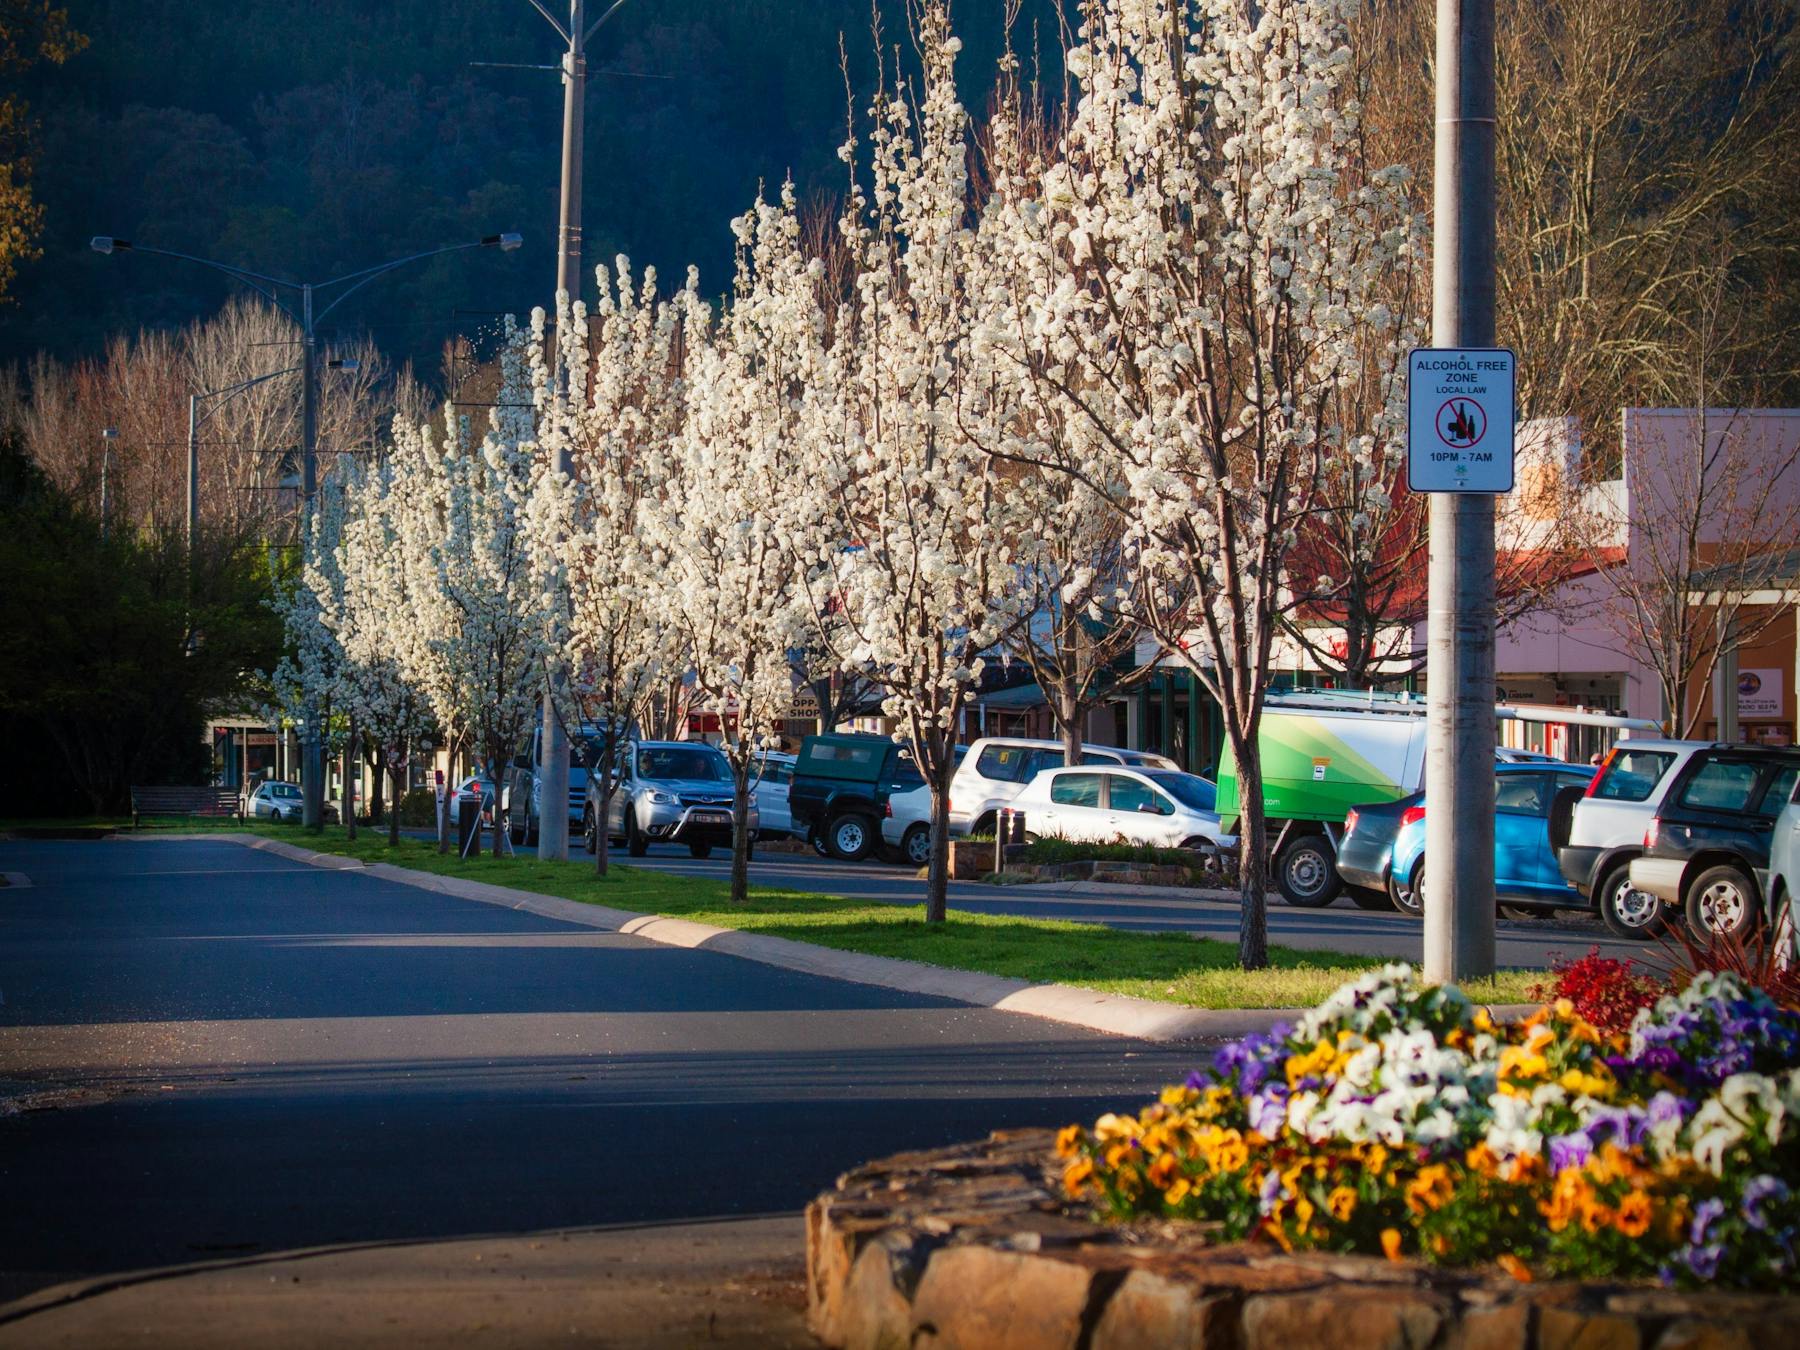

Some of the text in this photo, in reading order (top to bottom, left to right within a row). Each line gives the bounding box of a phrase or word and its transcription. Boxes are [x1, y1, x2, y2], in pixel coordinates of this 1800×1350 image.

[1417, 361, 1508, 371] ALCOHOL FREE
[1446, 373, 1478, 383] ZONE
[1436, 386, 1487, 394] LOCAL LAW
[1430, 452, 1459, 462] 10PM
[1469, 452, 1493, 462] 7AM
[792, 699, 818, 707] OPP.
[790, 709, 821, 718] SHOP
